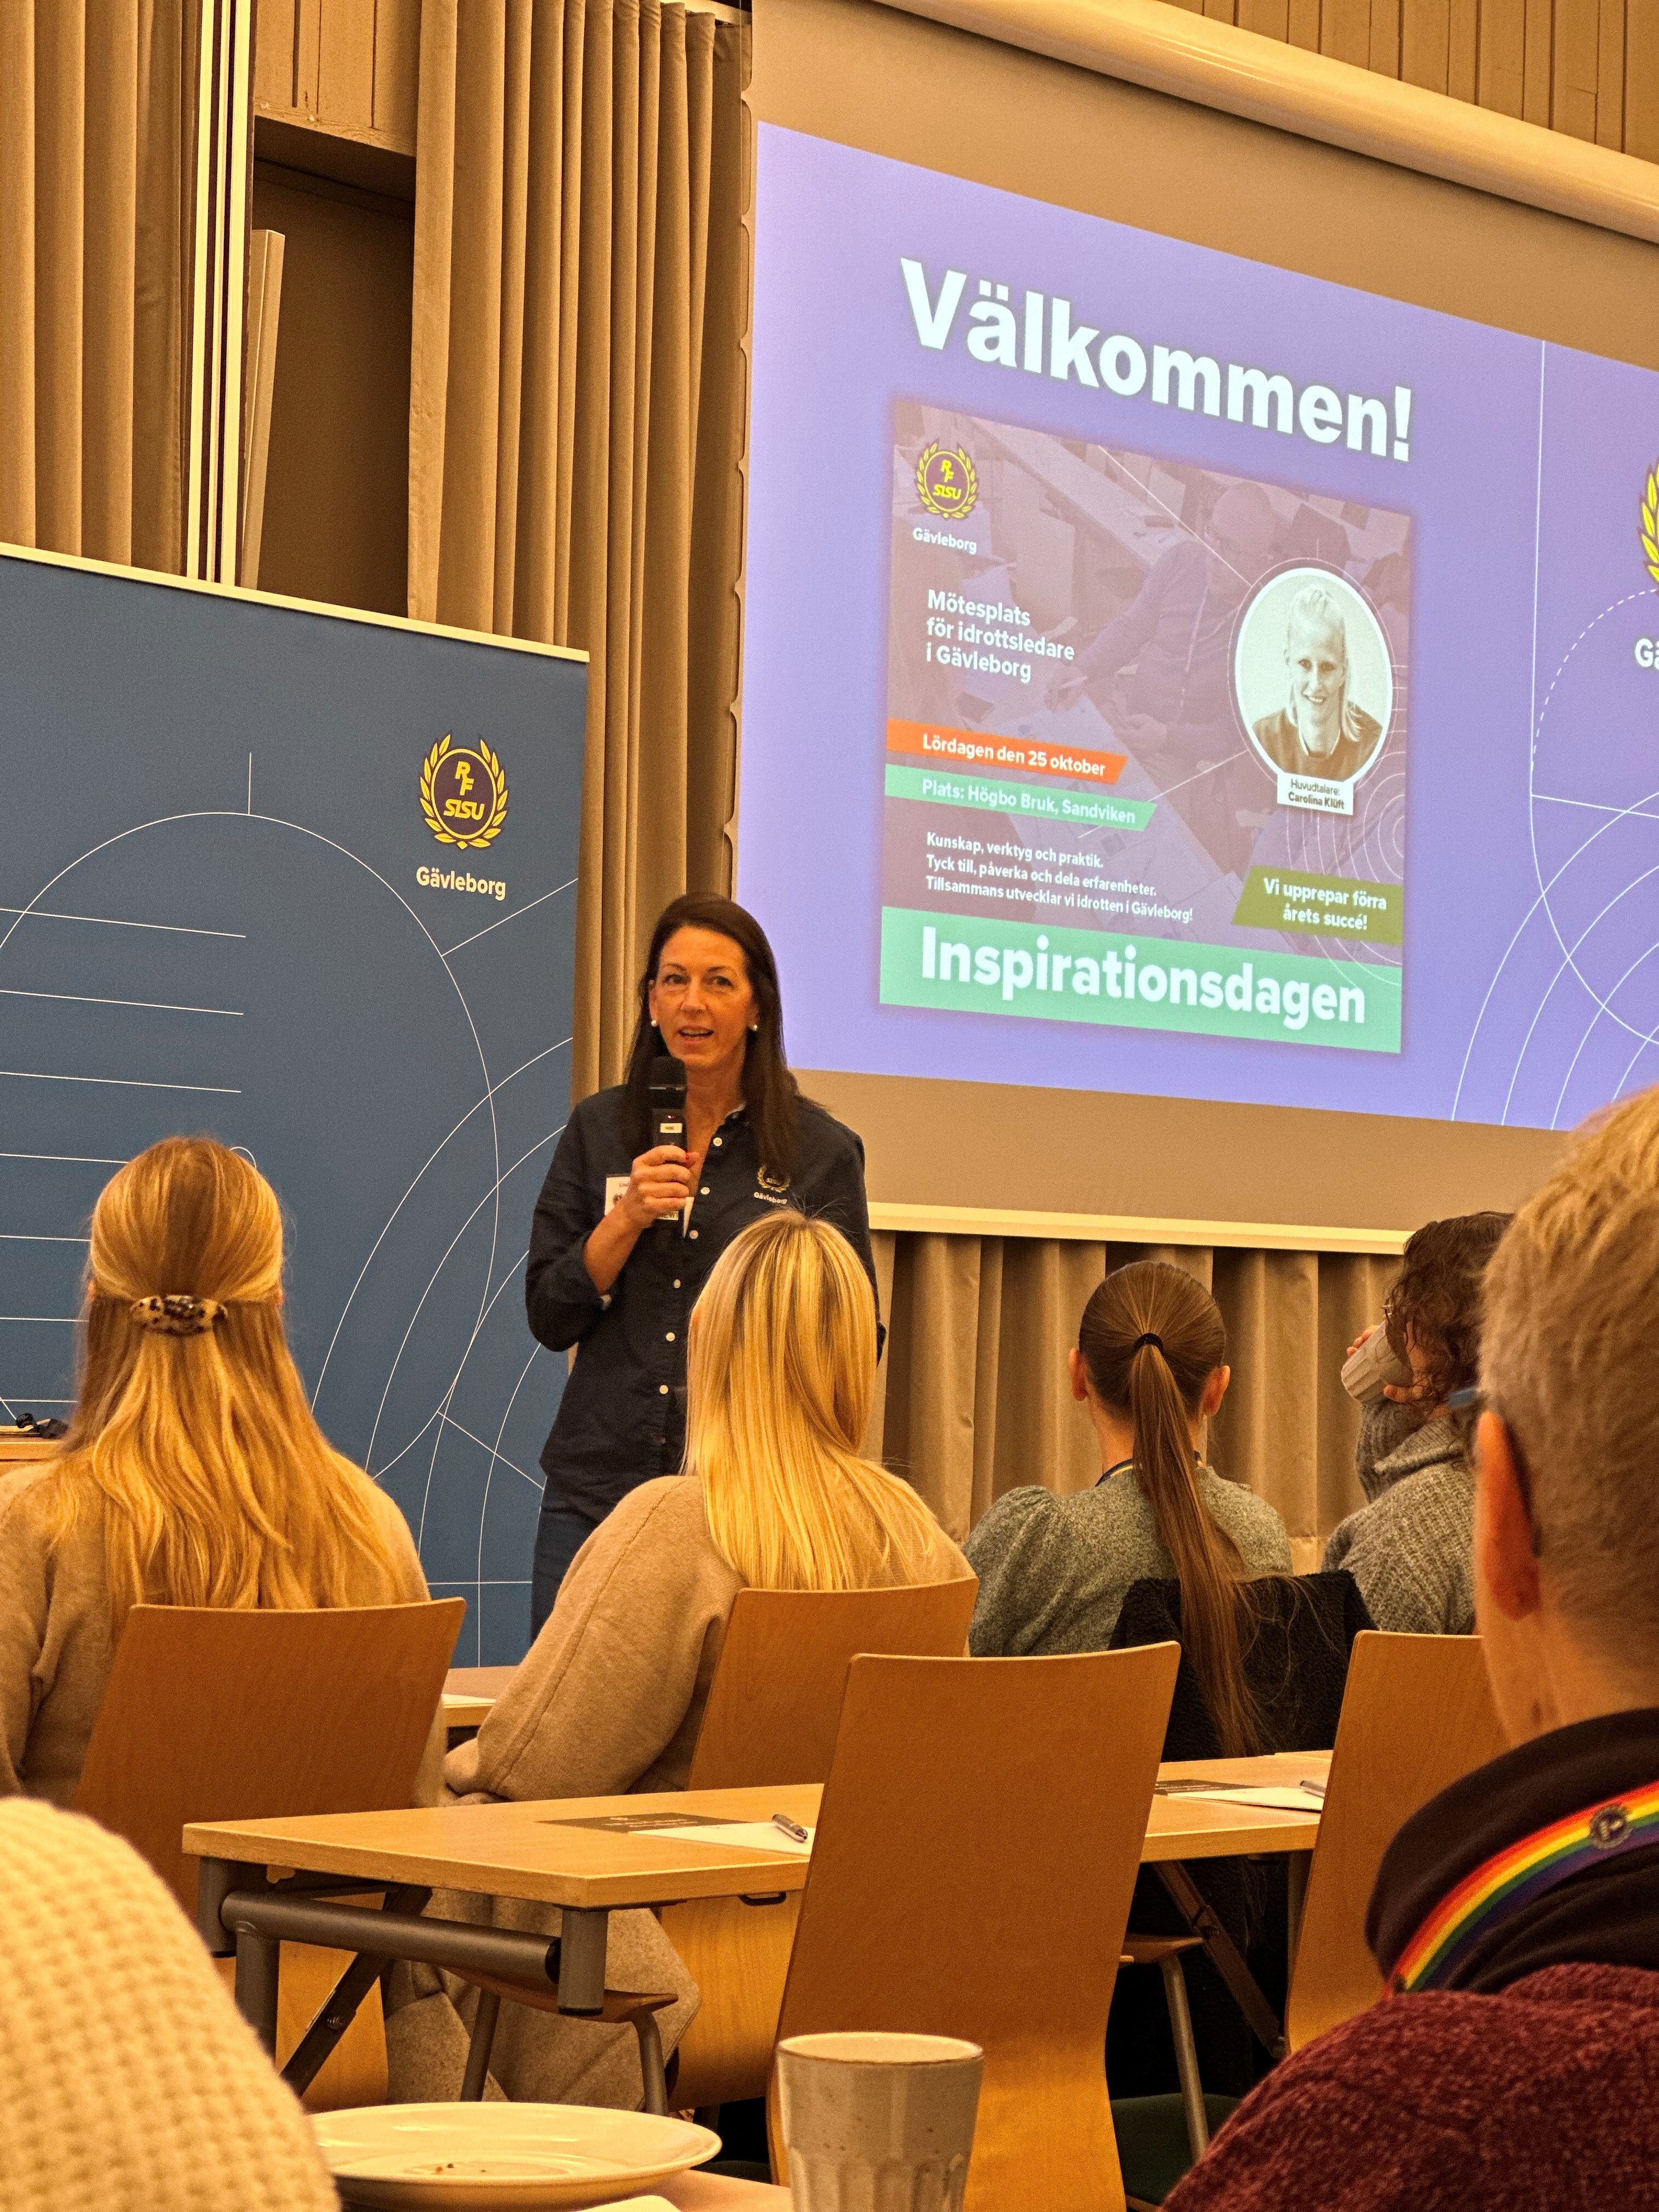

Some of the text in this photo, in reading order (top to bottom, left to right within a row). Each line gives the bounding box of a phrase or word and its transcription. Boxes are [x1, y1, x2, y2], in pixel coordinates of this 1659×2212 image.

[900, 257, 1411, 462] Välkommen!
[933, 484, 962, 500] SISU
[912, 527, 977, 555] Gävleborg
[928, 589, 1030, 627] Mötesplats
[927, 617, 1075, 661] för idrottsledare
[927, 642, 1031, 684] i Gävleborg
[923, 733, 1105, 776] Lördagen den 25 oktober
[922, 778, 1136, 824] Plats: Högbo Bruk, Sandviken
[1288, 792, 1345, 810] Carolina Klüft
[1290, 778, 1340, 796] Huvudtalare:
[443, 799, 485, 821] SISU
[927, 832, 1103, 869] Kunskap, verktyg och praktik.
[416, 866, 506, 901] Gävleborg
[927, 854, 1157, 897] Tyck till, påverka och dela erfarenheter.
[1263, 878, 1387, 910] Vi upprepar förra
[926, 876, 1193, 923] Tillsammans utvecklar vi idrotten i Gävleborg!
[1283, 903, 1368, 930] årets succé!
[922, 926, 1365, 1031] Inspirationsdagen
